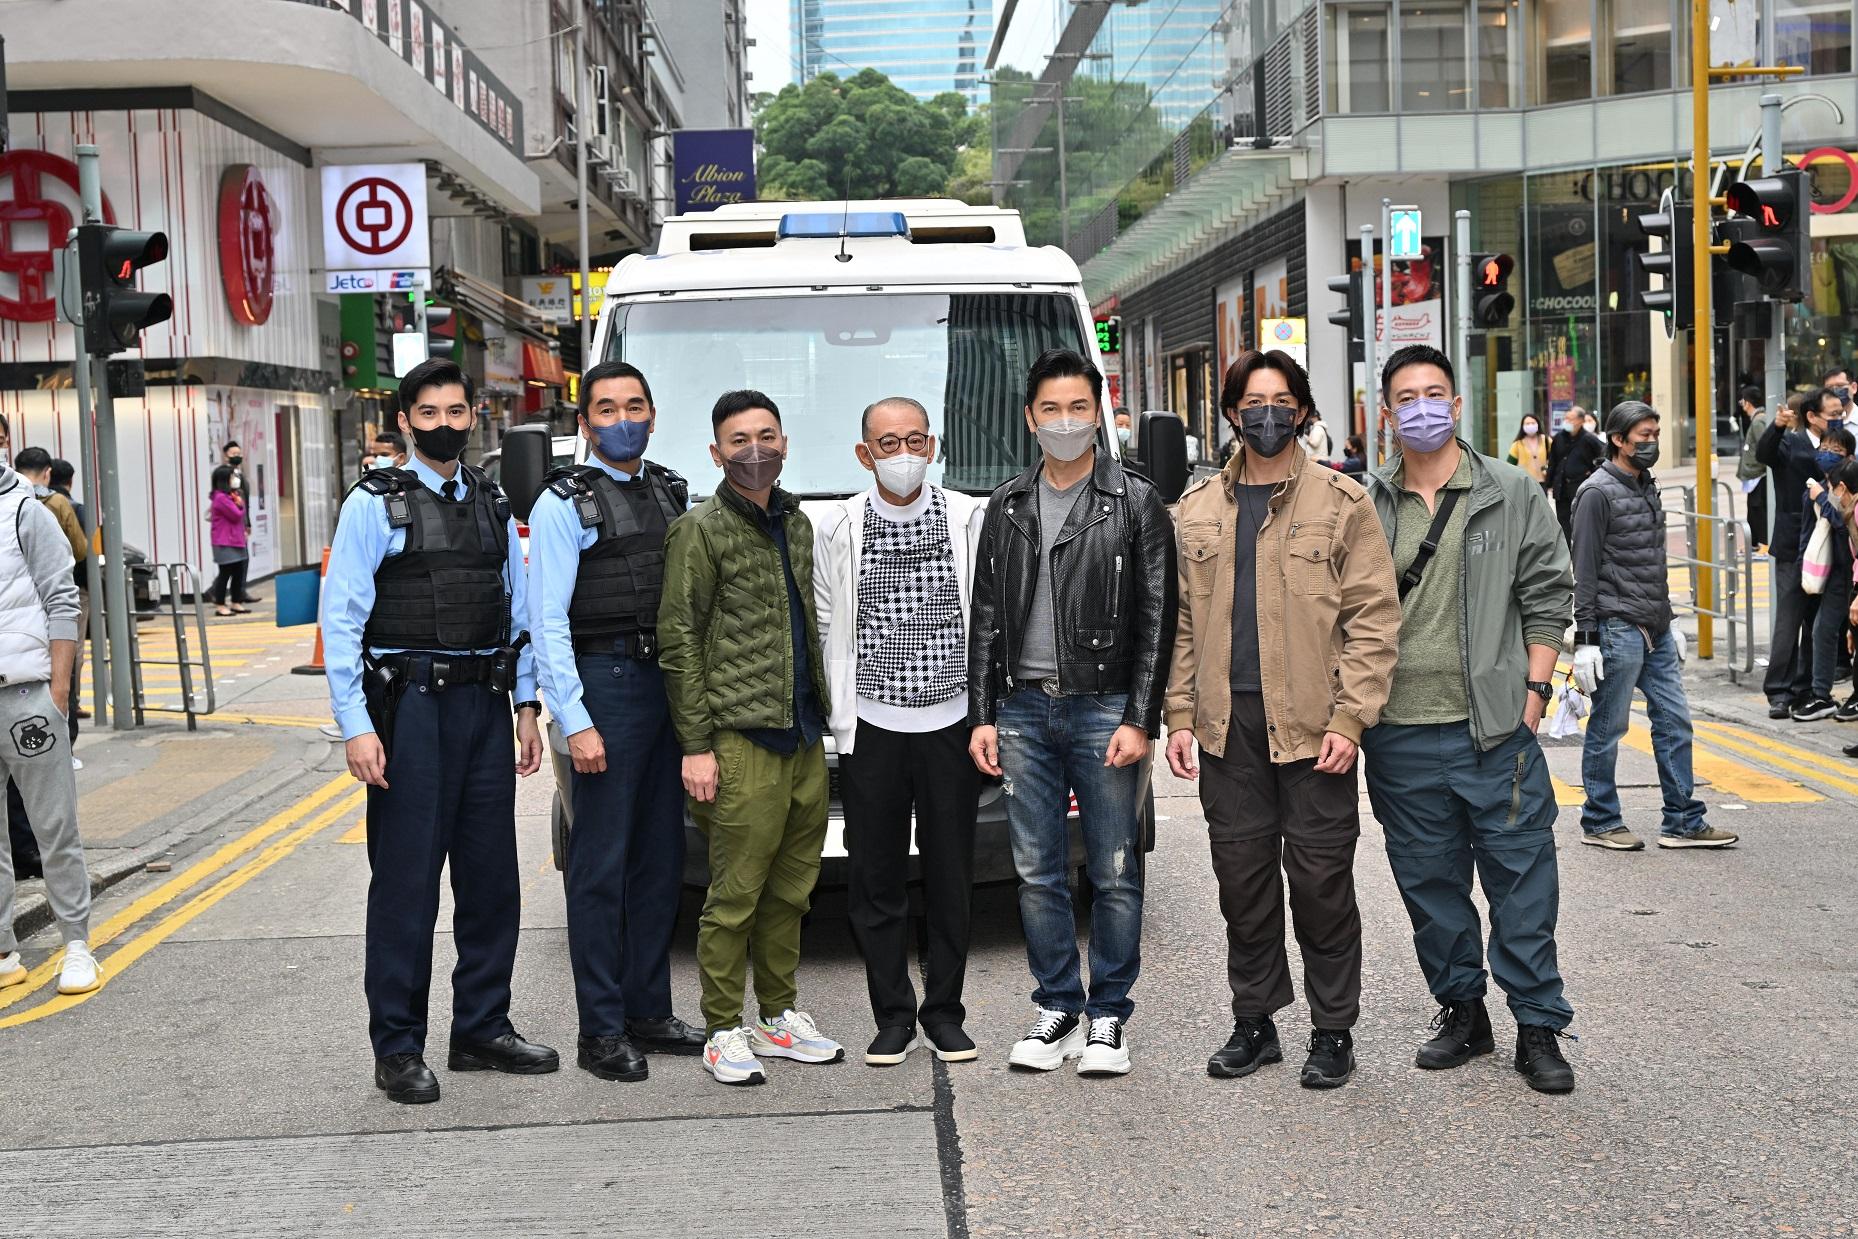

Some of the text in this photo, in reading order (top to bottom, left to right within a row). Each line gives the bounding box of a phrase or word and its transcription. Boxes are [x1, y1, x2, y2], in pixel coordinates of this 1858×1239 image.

[681, 164, 745, 182] Albion
[687, 184, 742, 204] Plaza
[1096, 322, 1109, 332] P1
[1097, 332, 1110, 342] P2
